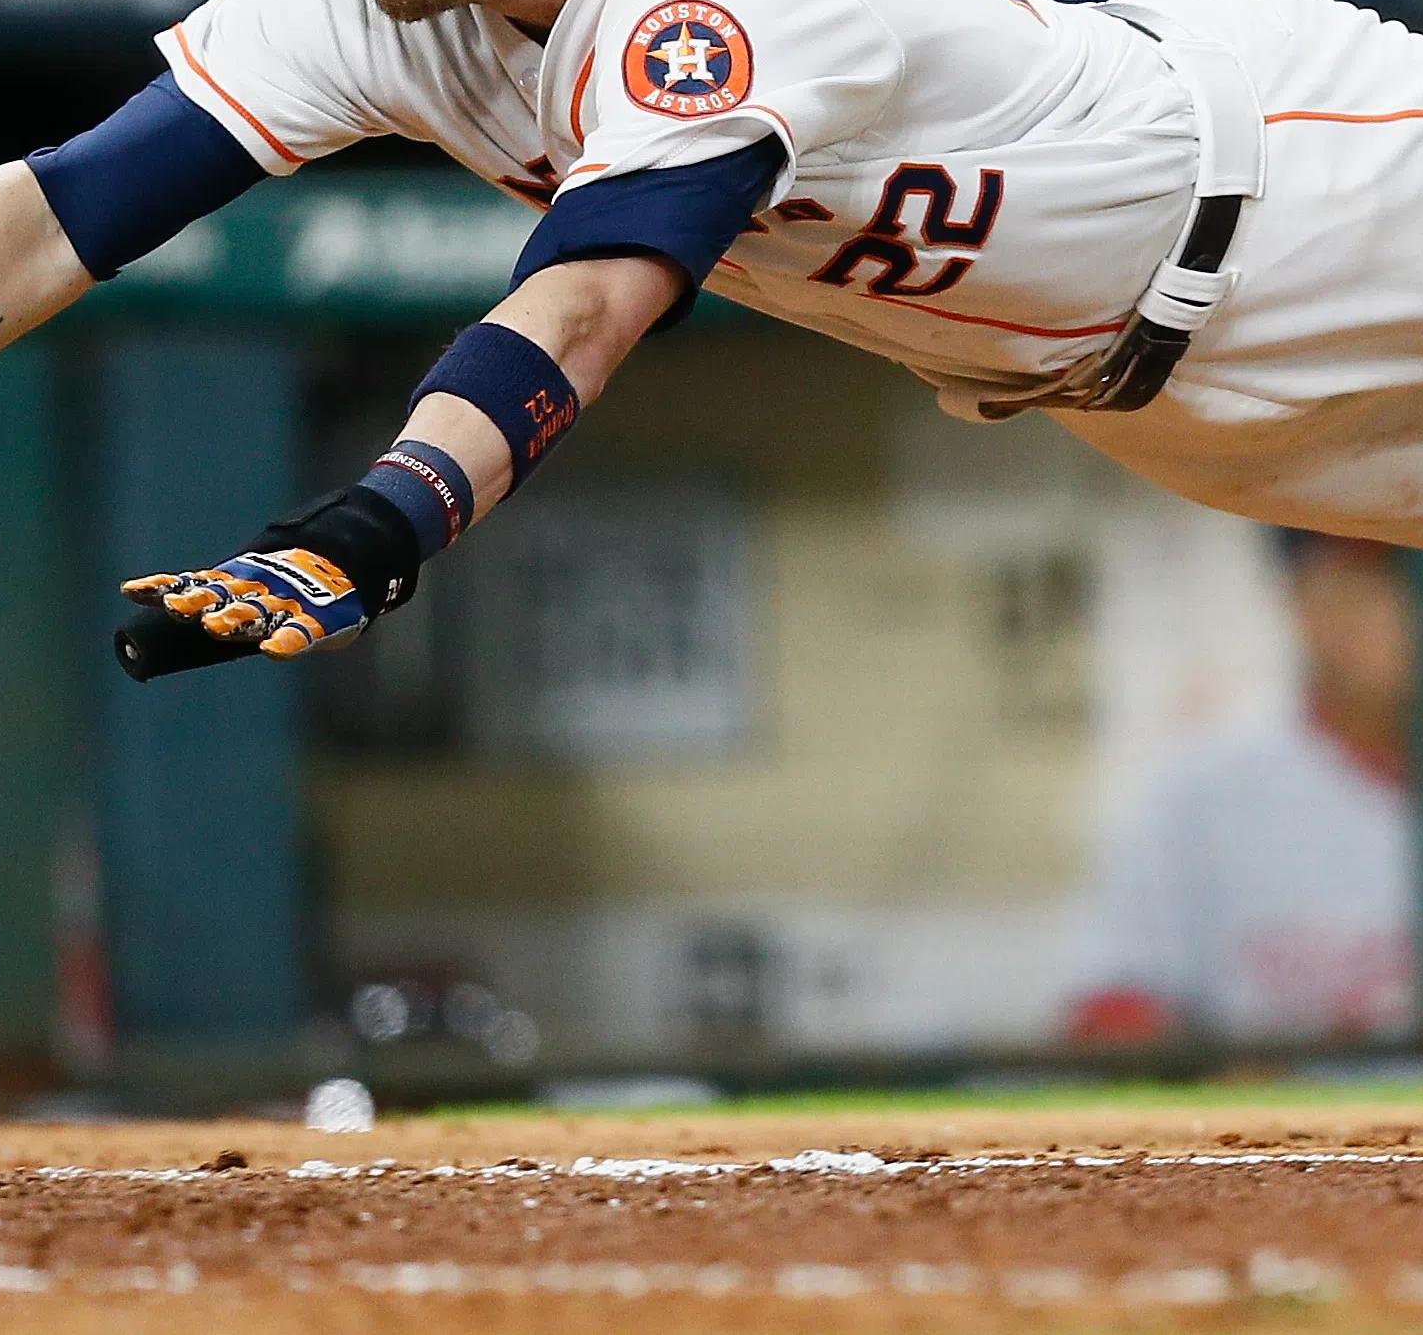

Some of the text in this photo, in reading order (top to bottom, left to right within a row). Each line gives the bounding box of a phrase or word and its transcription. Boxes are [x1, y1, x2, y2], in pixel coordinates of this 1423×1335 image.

[634, 3, 738, 46] HOUSTON
[660, 38, 715, 82] H
[643, 87, 737, 112] ASTROS
[806, 162, 1006, 298] 22
[524, 388, 556, 424] 22
[434, 478, 456, 509] THE
